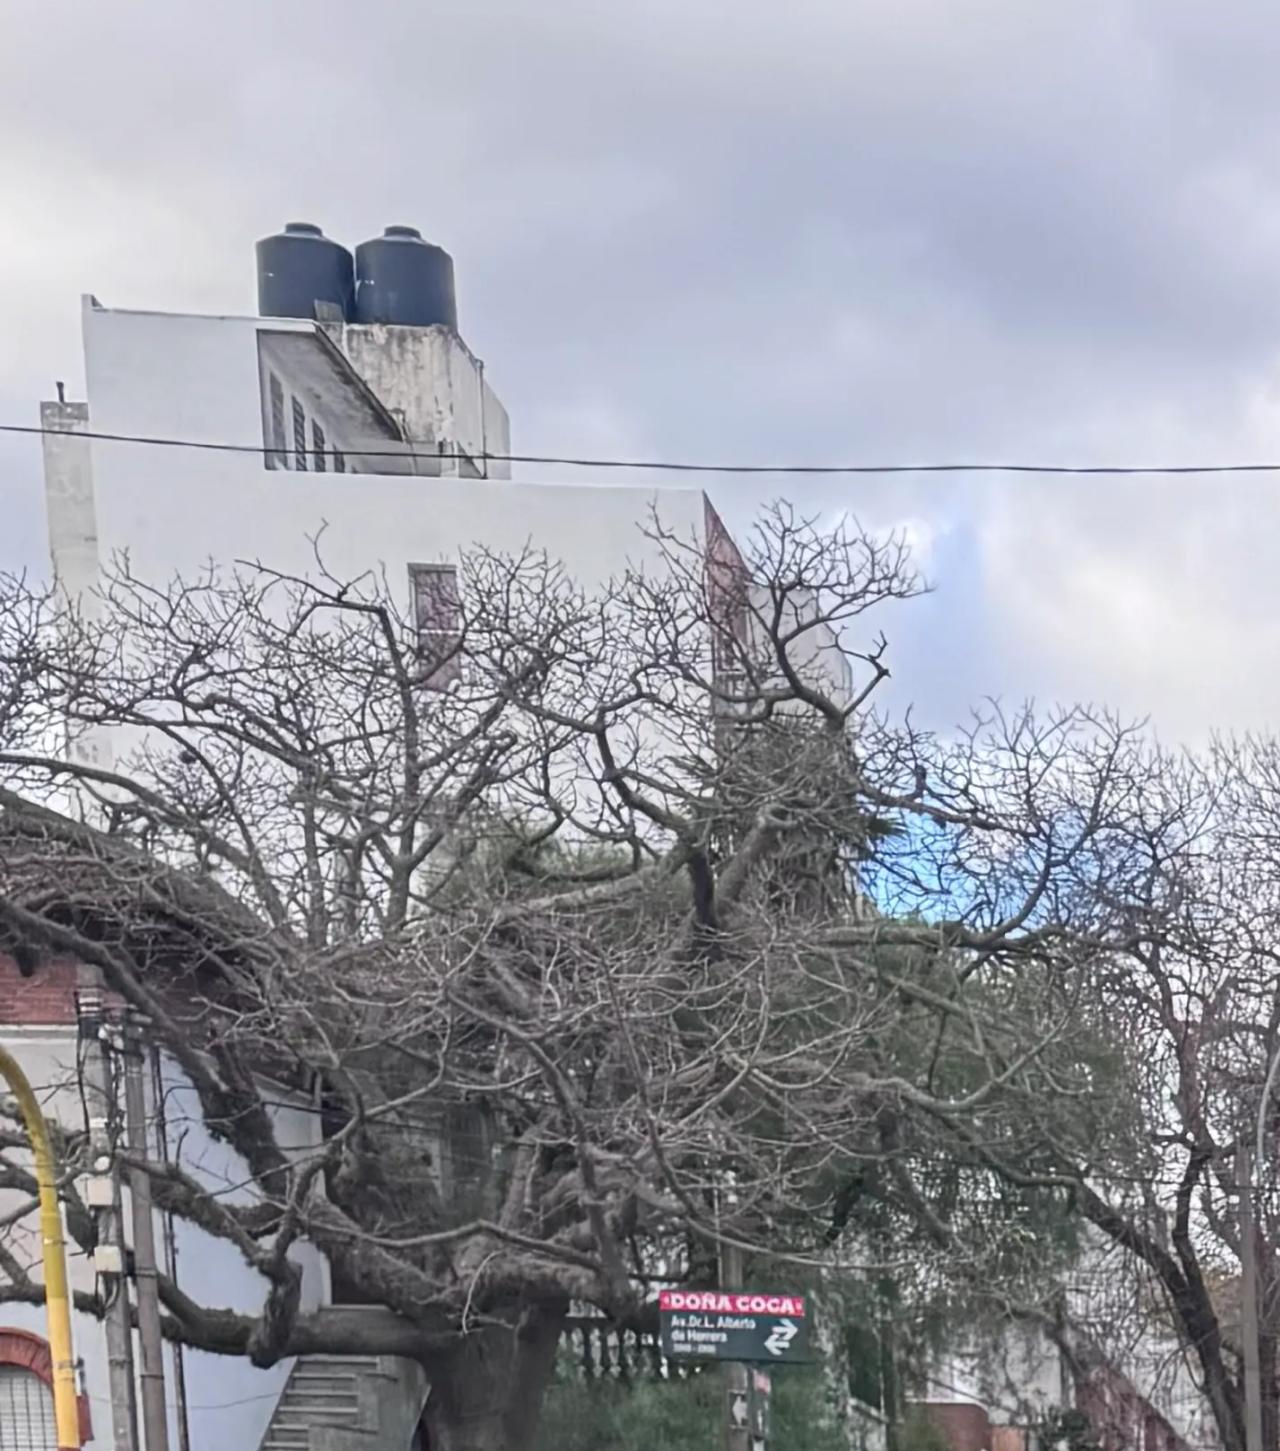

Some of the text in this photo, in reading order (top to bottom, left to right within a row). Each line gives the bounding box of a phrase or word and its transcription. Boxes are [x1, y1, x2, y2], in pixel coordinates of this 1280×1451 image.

[671, 1292, 796, 1313] DOÑA COCA
[717, 1315, 756, 1329] Alberto
[671, 1329, 728, 1343] de Herrera
